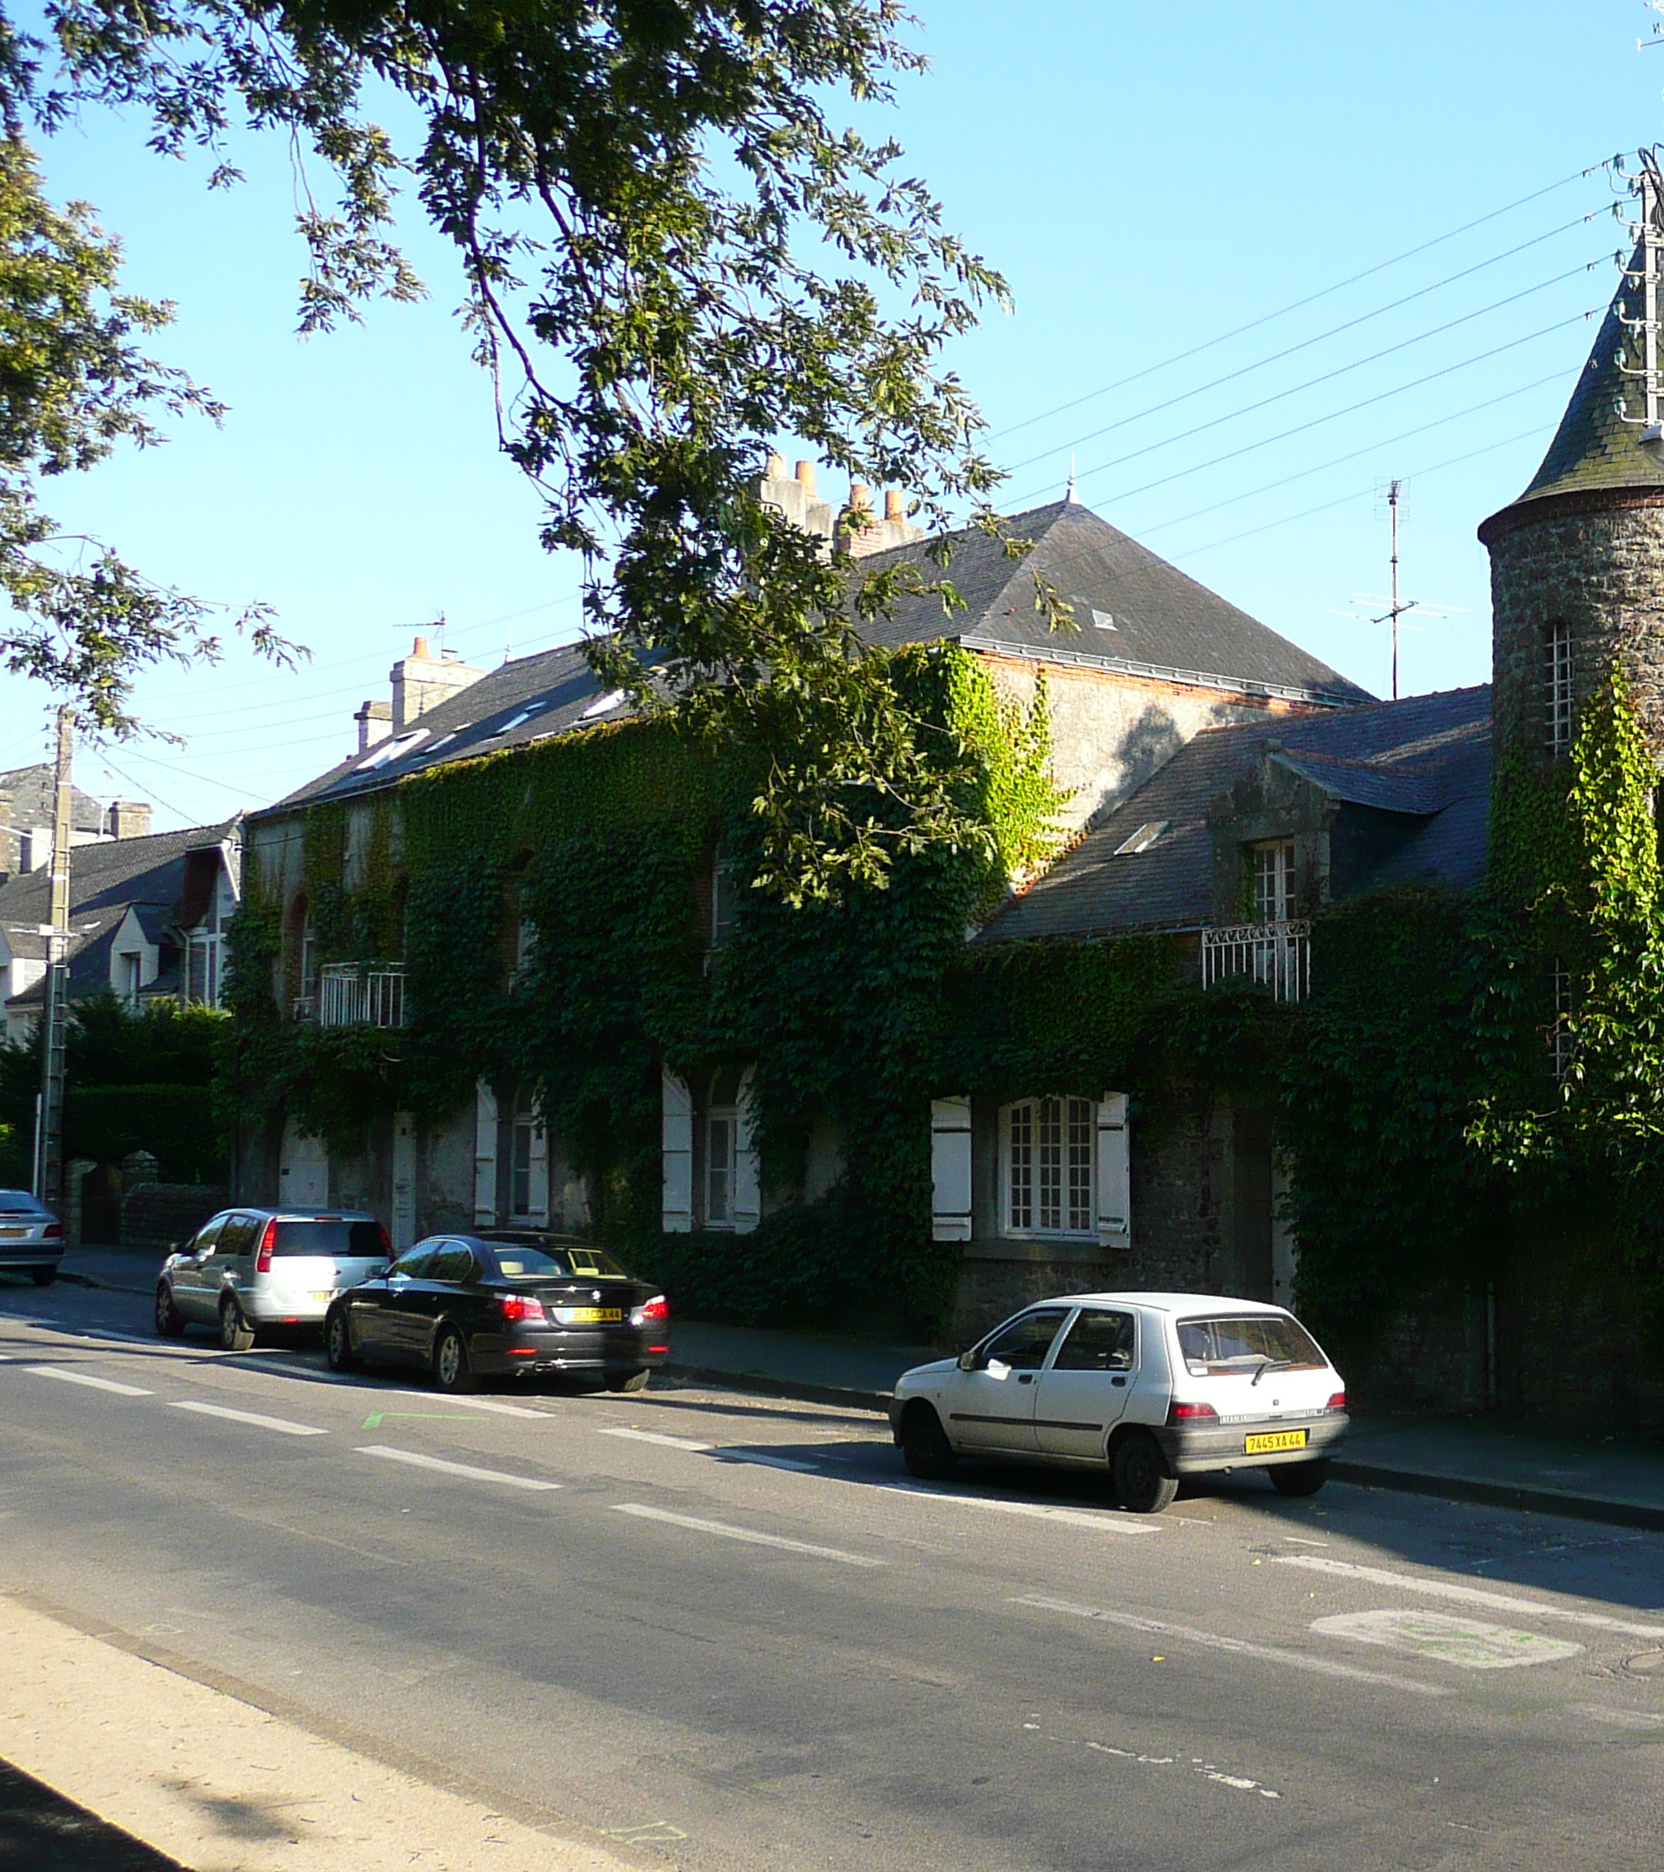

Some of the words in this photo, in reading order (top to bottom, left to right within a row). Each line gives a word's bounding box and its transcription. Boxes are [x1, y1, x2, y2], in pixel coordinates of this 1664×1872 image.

[1249, 1436, 1274, 1451] 7445
[1275, 1434, 1287, 1448] XA
[1289, 1433, 1301, 1446] 44
